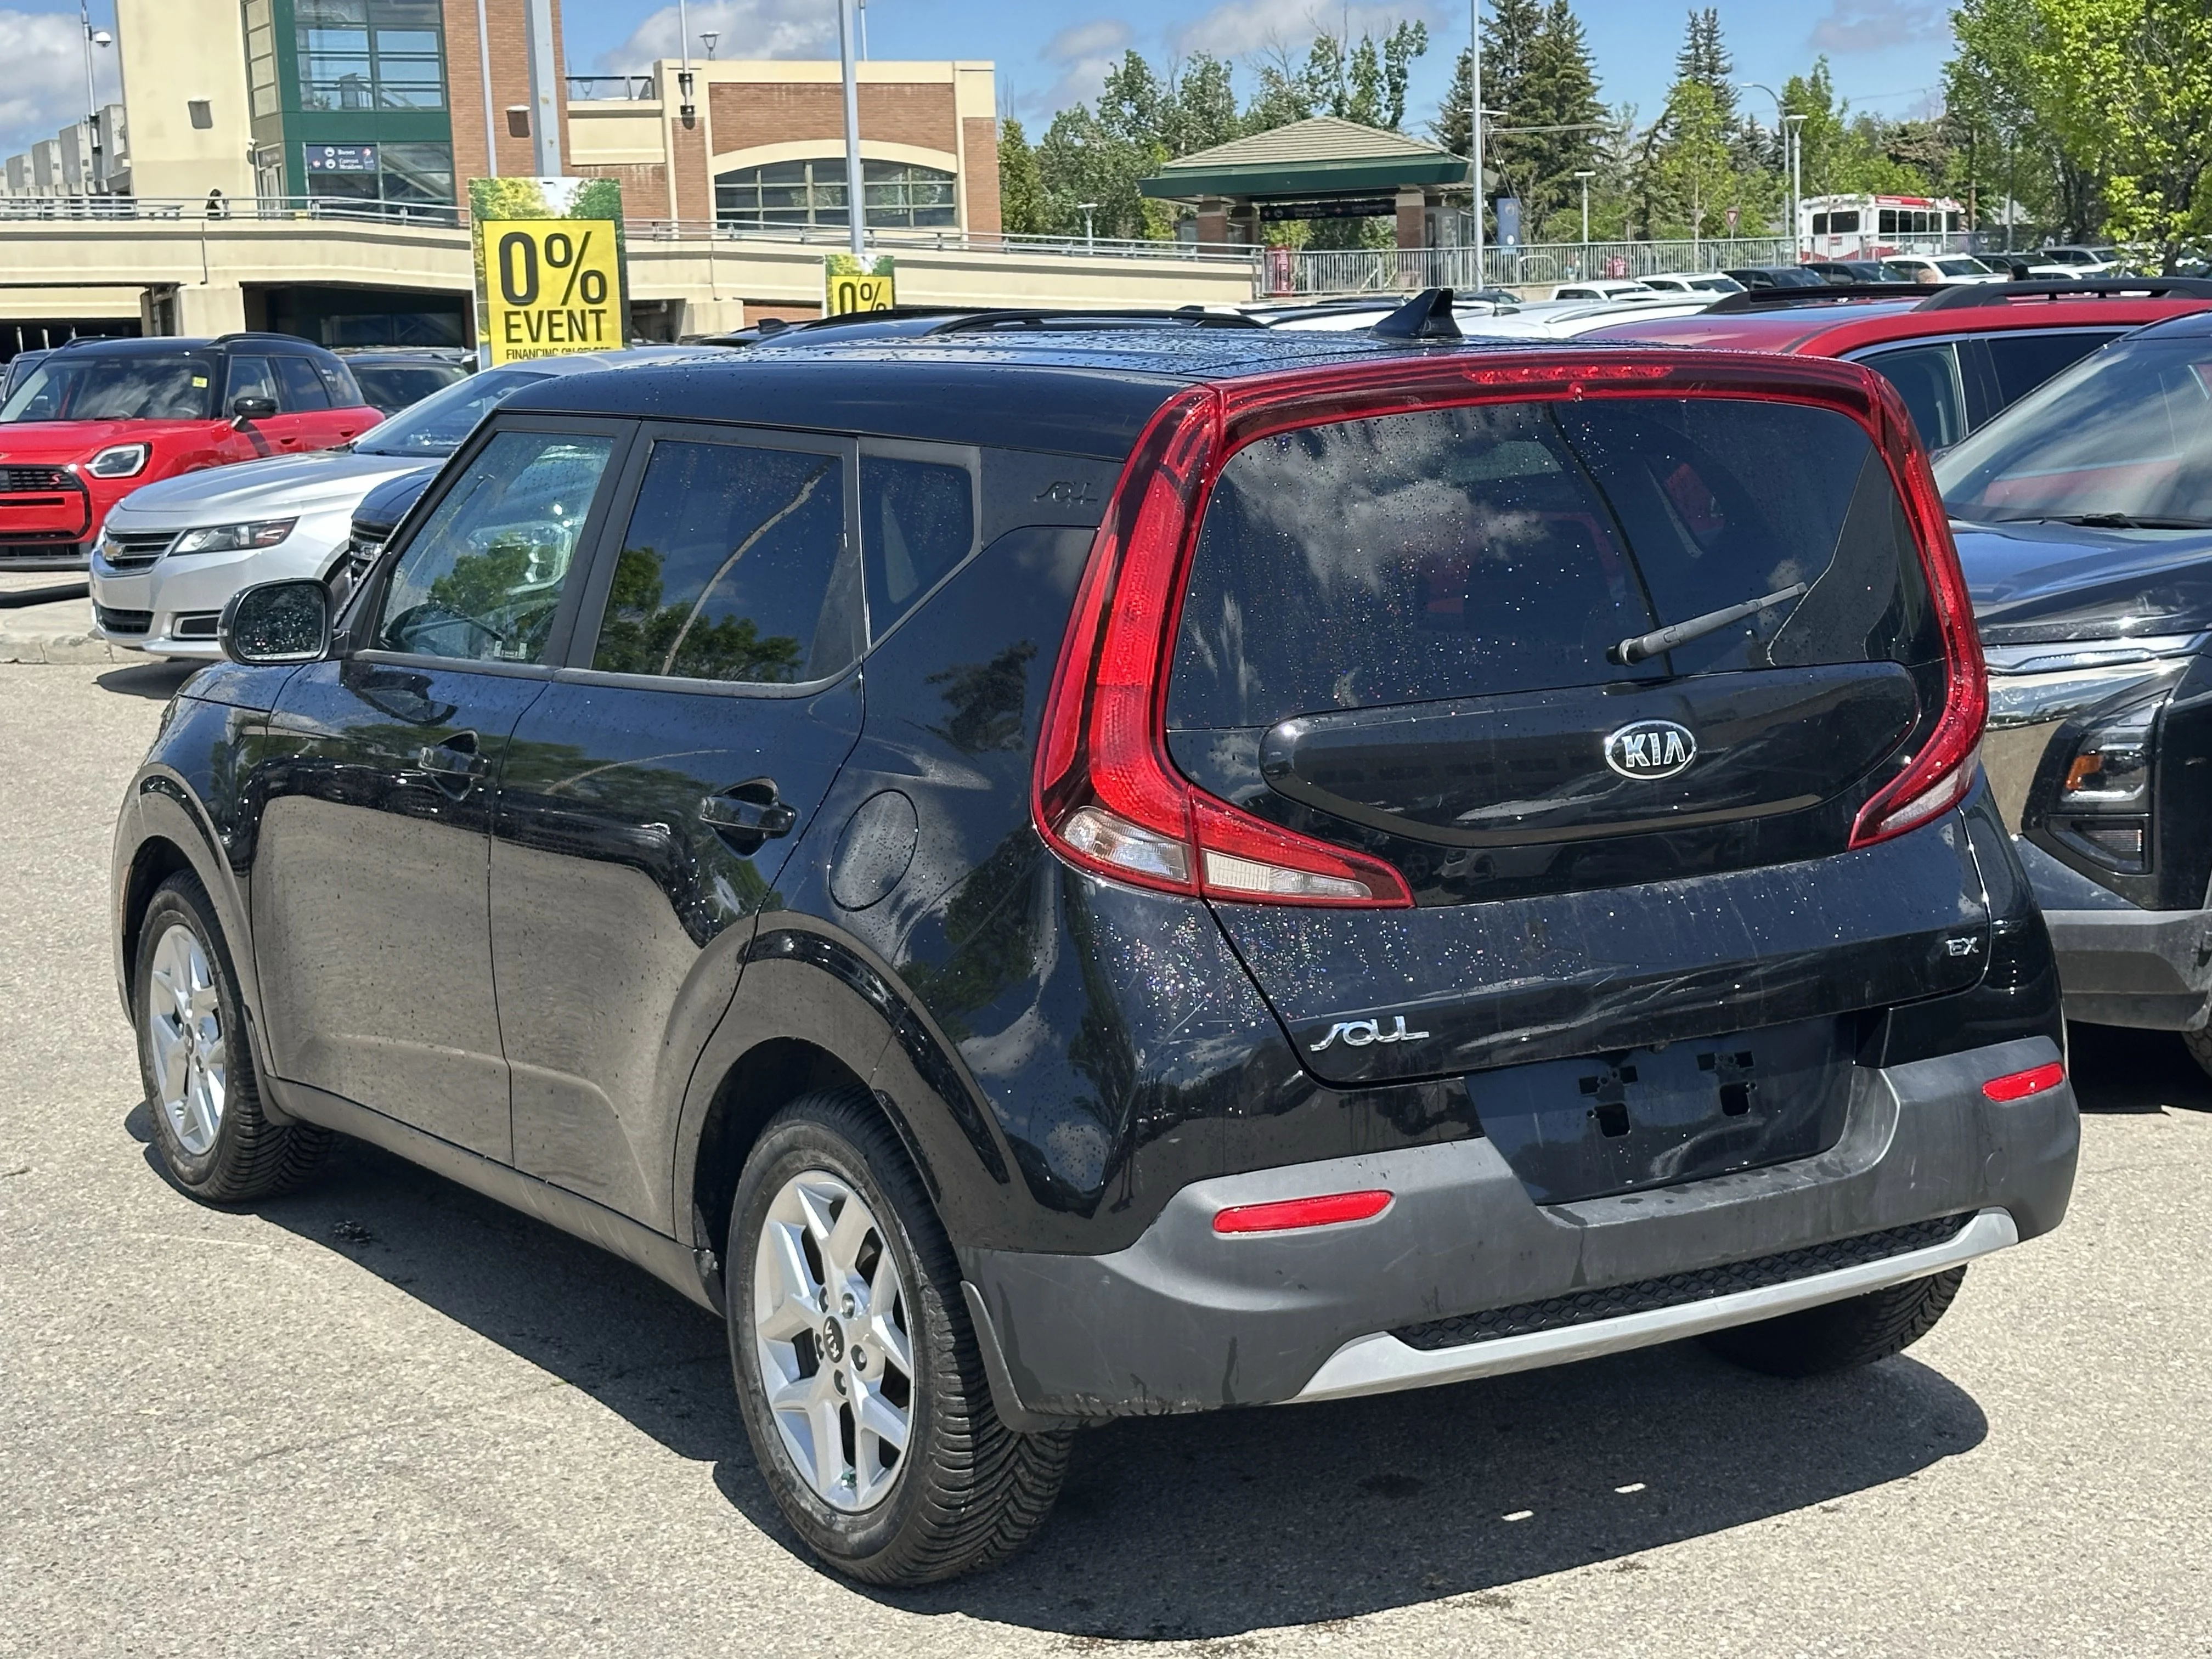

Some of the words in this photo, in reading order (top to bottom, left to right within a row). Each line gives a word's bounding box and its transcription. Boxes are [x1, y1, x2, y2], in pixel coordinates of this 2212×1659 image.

[499, 231, 607, 307] 0%
[504, 308, 607, 344] EVENT
[1621, 731, 1686, 768] KIA
[1945, 936, 1979, 956] EX
[825, 1321, 839, 1358] KIA
